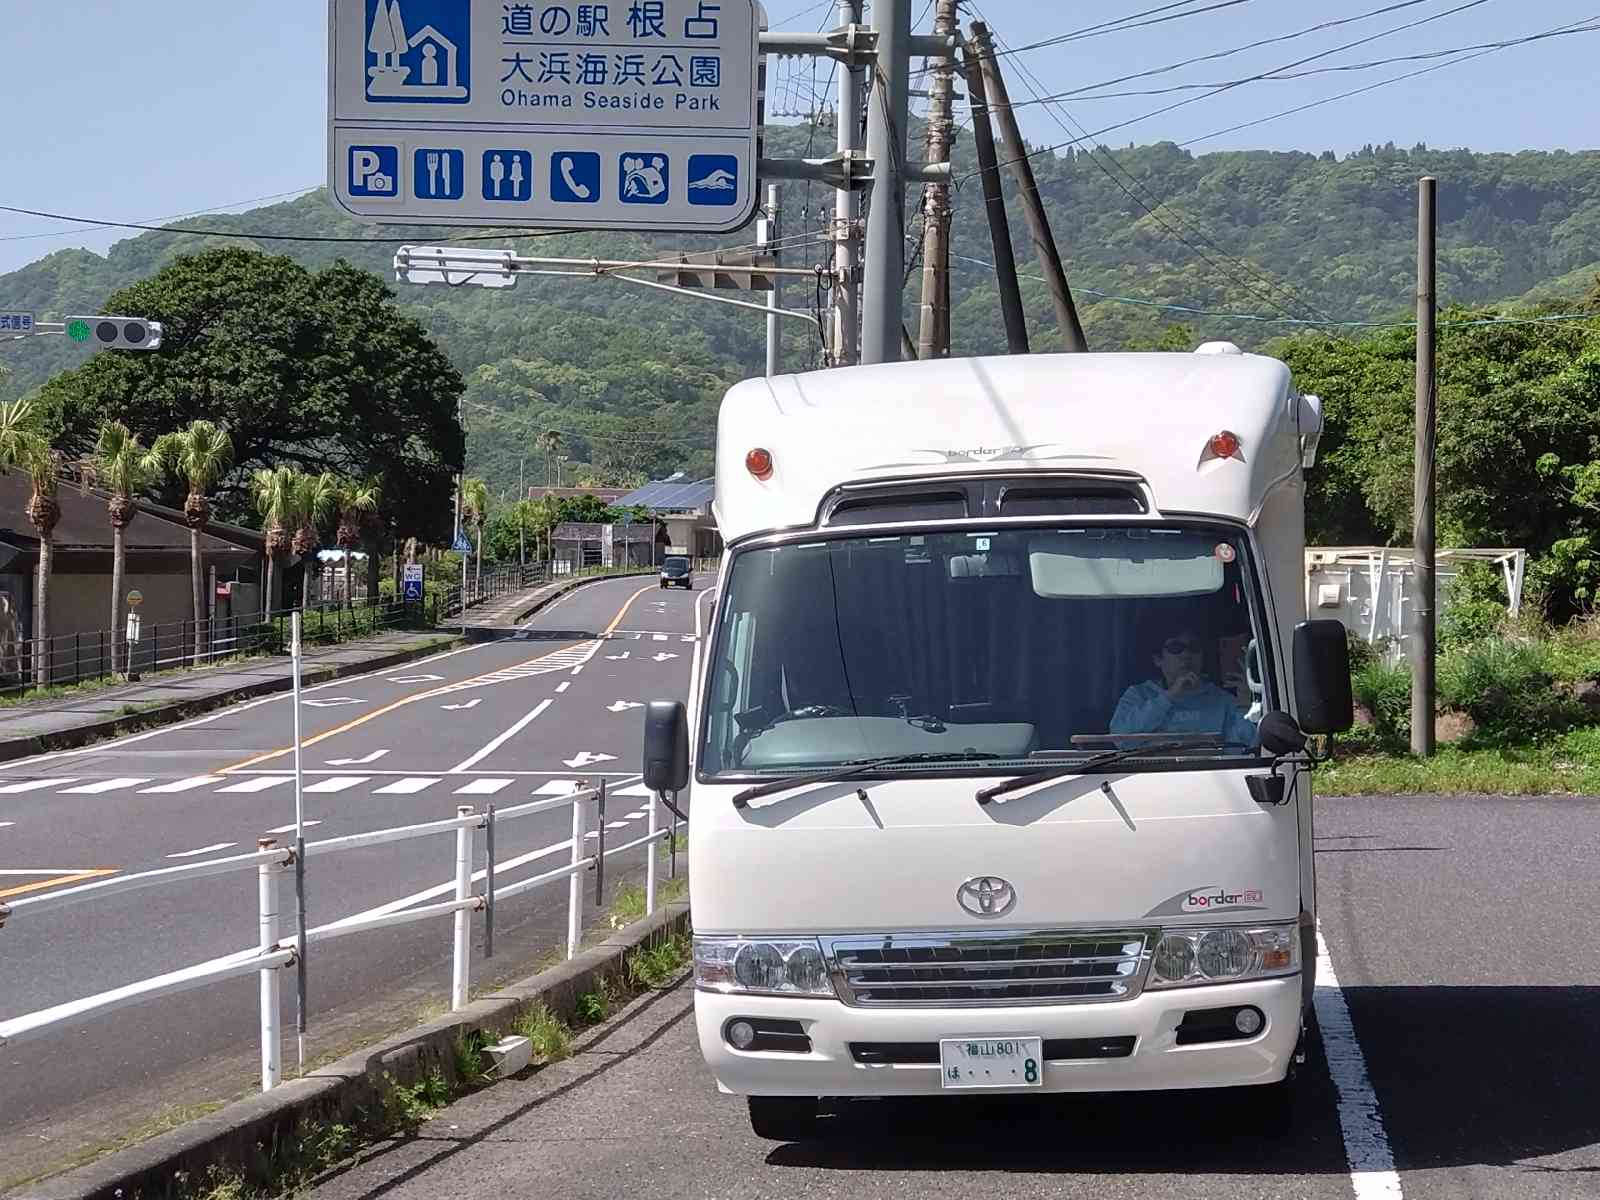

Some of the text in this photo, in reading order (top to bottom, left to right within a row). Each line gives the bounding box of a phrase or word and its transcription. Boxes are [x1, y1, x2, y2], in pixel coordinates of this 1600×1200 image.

[501, 0, 721, 39] 道の駅 根占
[501, 52, 721, 88] 大浜海浜公園
[501, 89, 720, 111] Ohama Seaside Park
[1187, 888, 1243, 907] border
